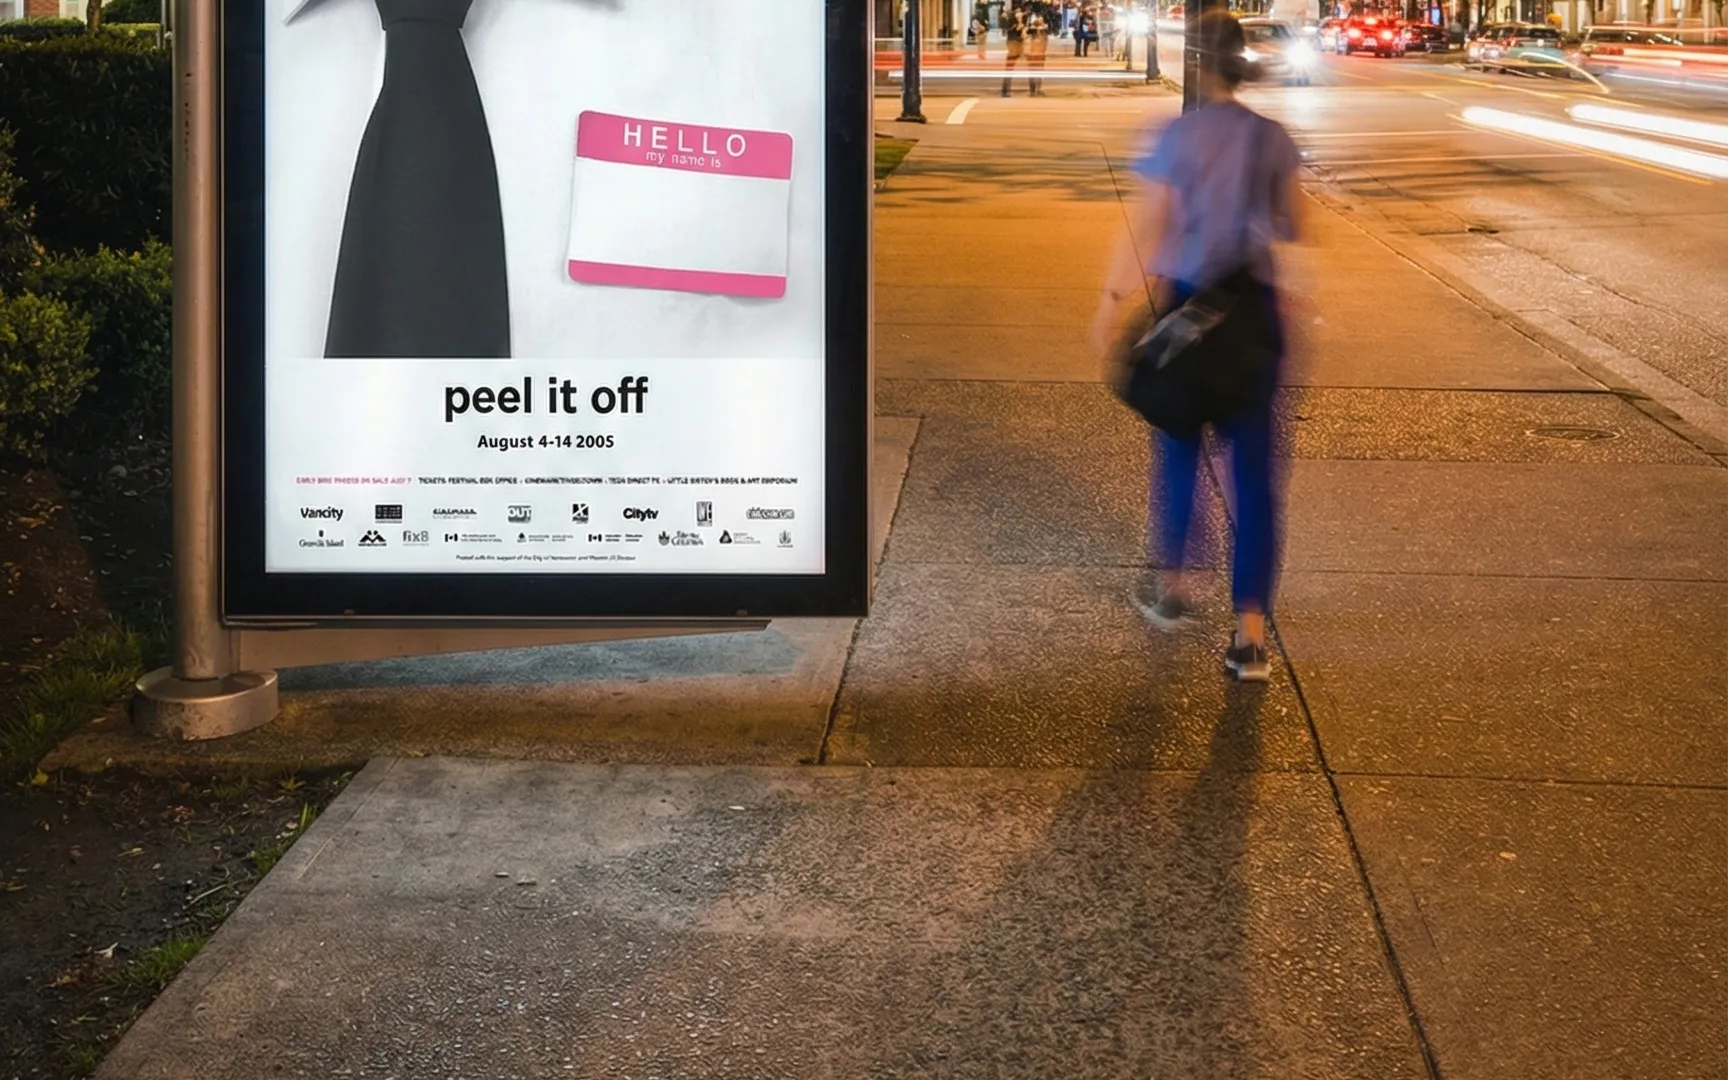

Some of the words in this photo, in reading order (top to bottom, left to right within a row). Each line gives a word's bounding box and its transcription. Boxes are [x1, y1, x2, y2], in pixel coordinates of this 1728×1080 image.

[623, 122, 747, 157] HELLO
[646, 151, 665, 165] my
[711, 156, 722, 168] is
[445, 376, 533, 422] peel
[548, 376, 578, 415] it
[590, 376, 649, 415] off
[477, 434, 534, 453] August
[538, 434, 573, 449] 4-14
[576, 434, 615, 449] 2005
[300, 506, 344, 522] Vancity
[507, 507, 532, 518] OUT
